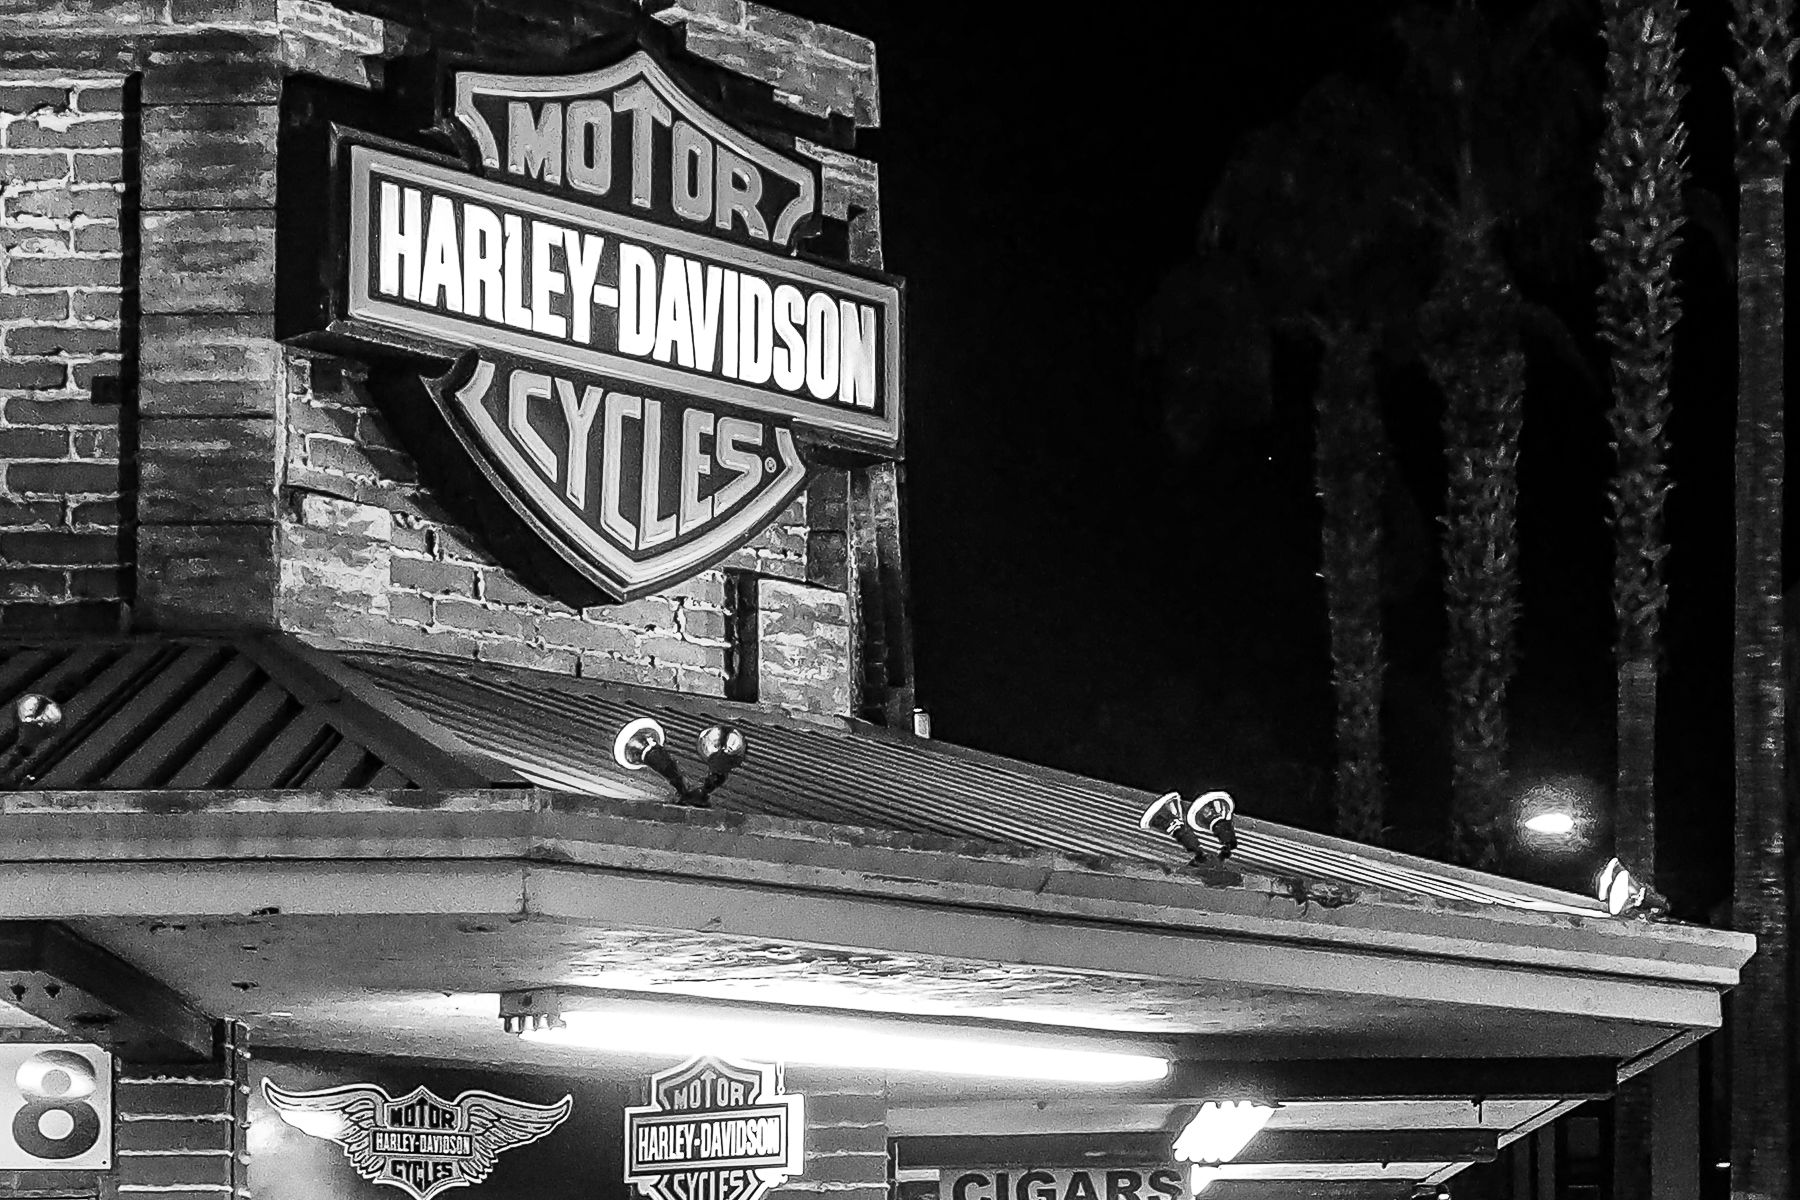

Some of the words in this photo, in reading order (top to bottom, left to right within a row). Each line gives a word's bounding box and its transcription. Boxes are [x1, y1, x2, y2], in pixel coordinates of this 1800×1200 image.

[507, 83, 767, 240] MOTOR
[379, 180, 876, 409] HARLEY-DAVIDSON
[509, 368, 764, 550] CYCLES
[674, 1070, 744, 1110] MOTOR
[390, 1097, 456, 1128] MOTOR
[375, 1132, 471, 1155] HARLEY-DAVIDSON
[638, 1117, 781, 1161] HARLEY-DAVIDSON
[390, 1159, 455, 1190] CYCLES
